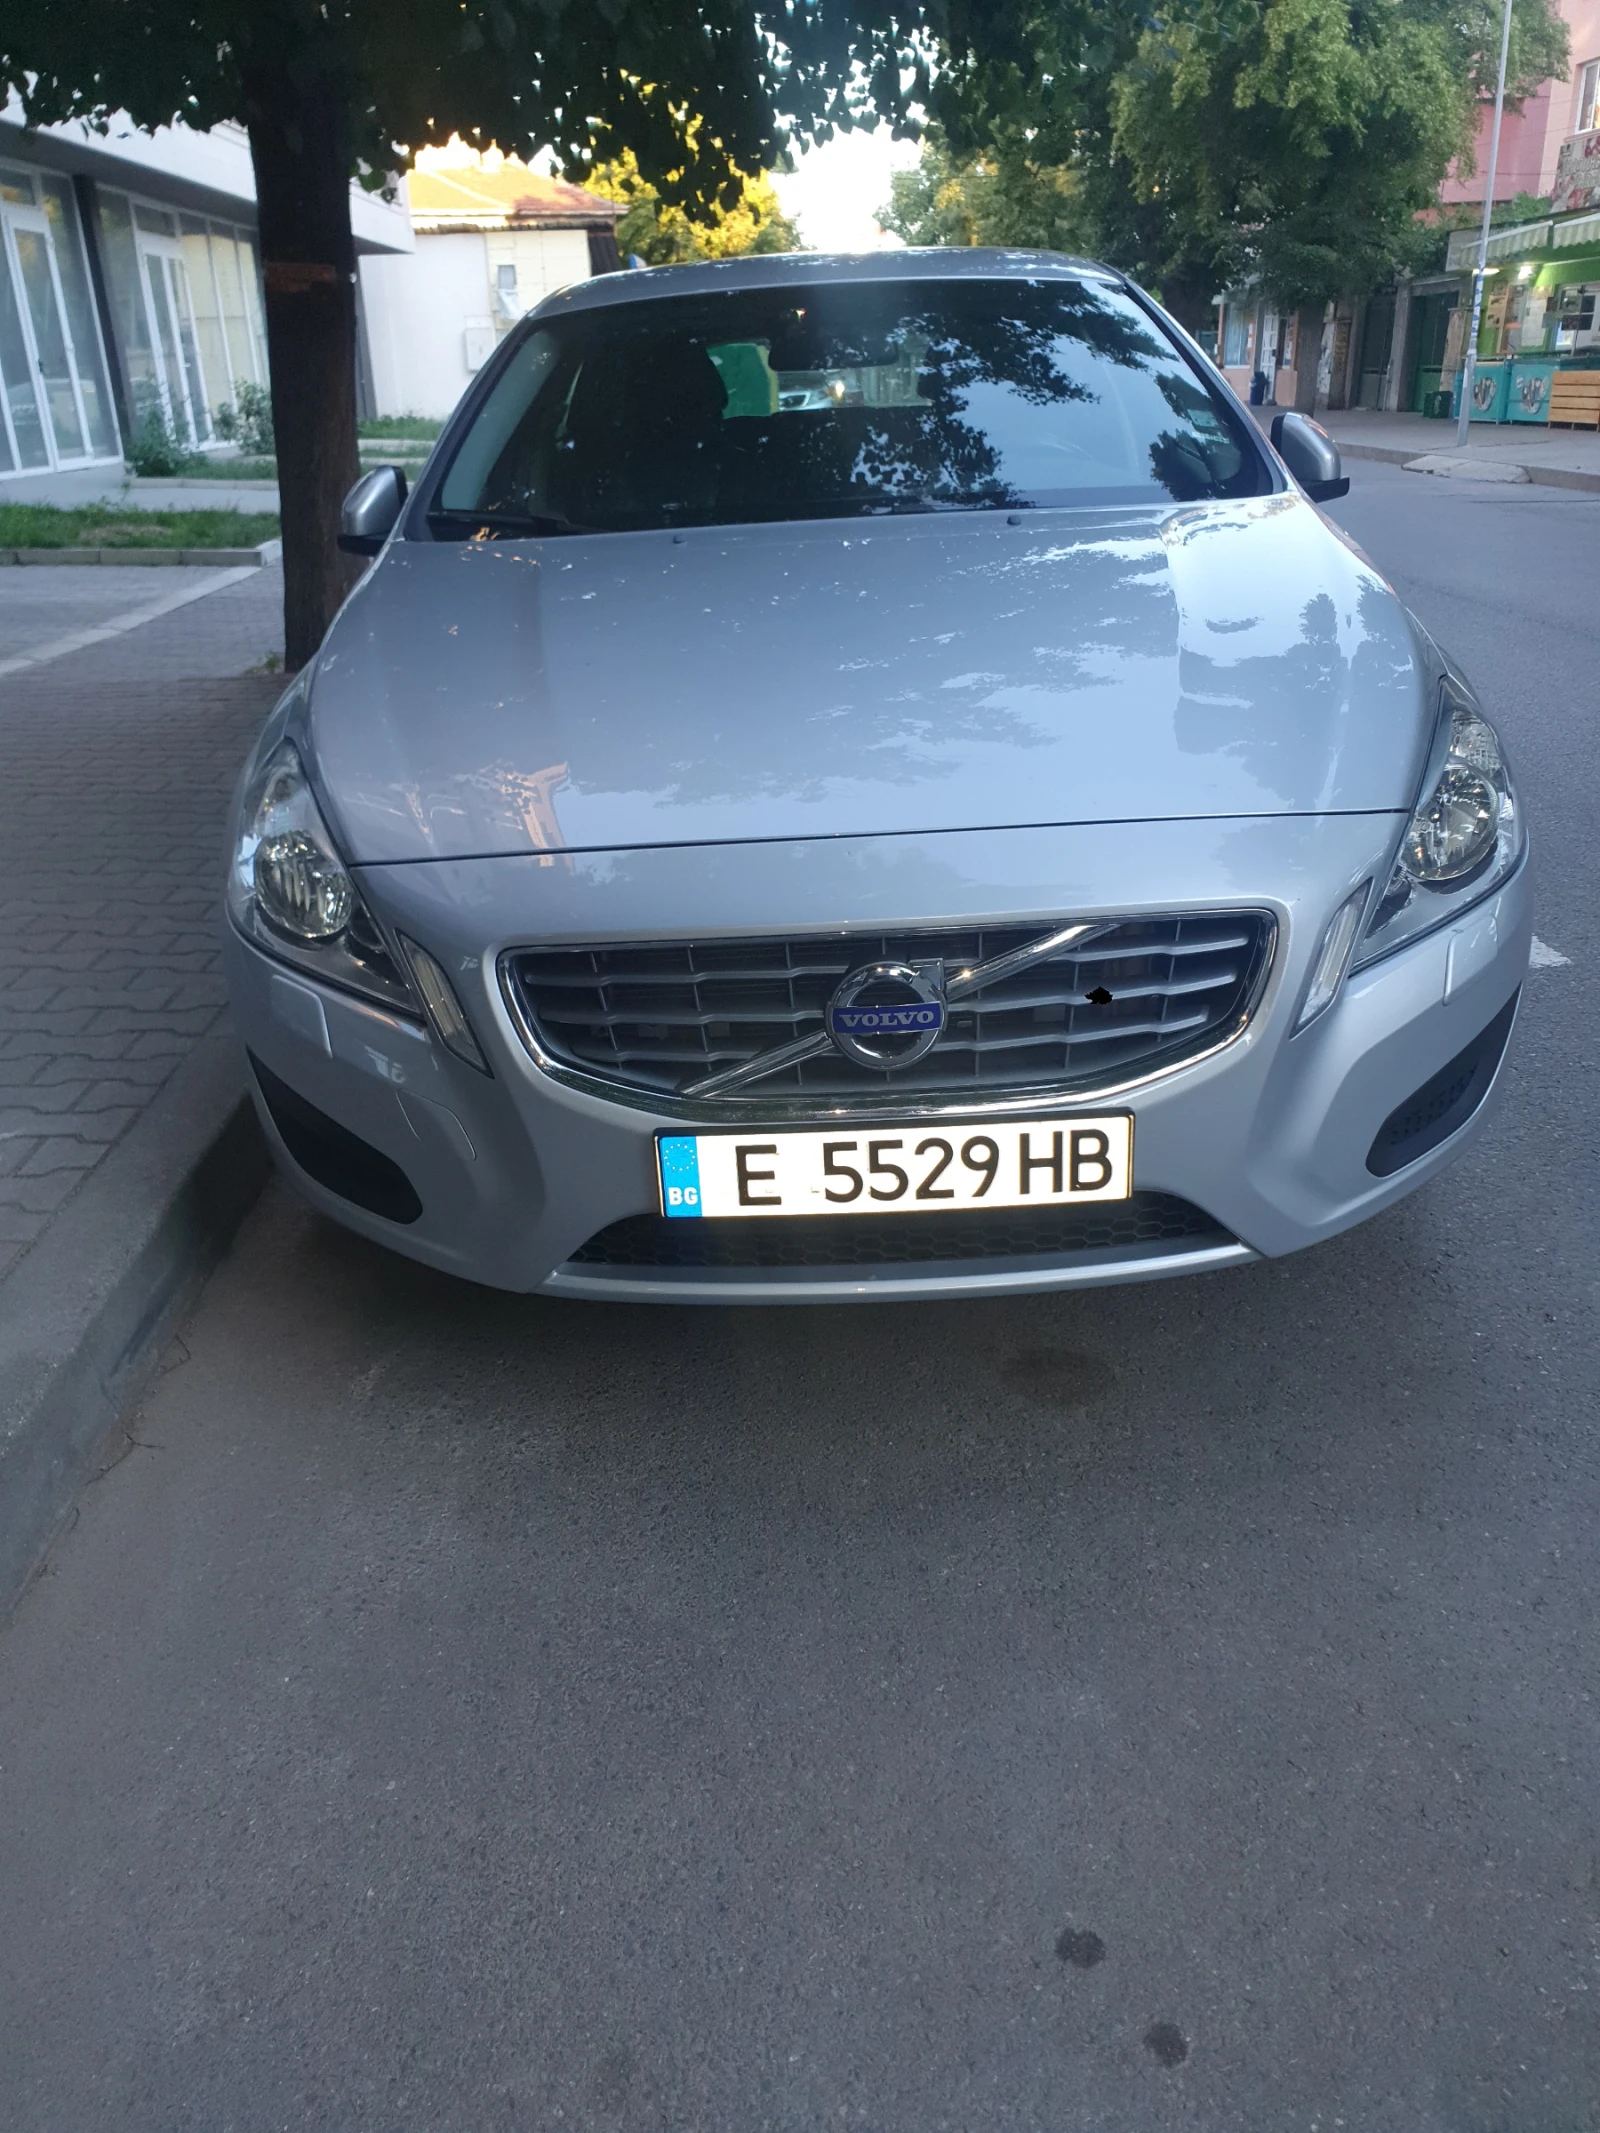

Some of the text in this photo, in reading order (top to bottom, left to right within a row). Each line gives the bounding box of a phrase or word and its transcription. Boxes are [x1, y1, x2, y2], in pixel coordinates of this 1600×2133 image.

[838, 1010, 934, 1028] VOLVO
[735, 1129, 1113, 1206] E 5529 HB
[668, 1186, 698, 1206] BG
